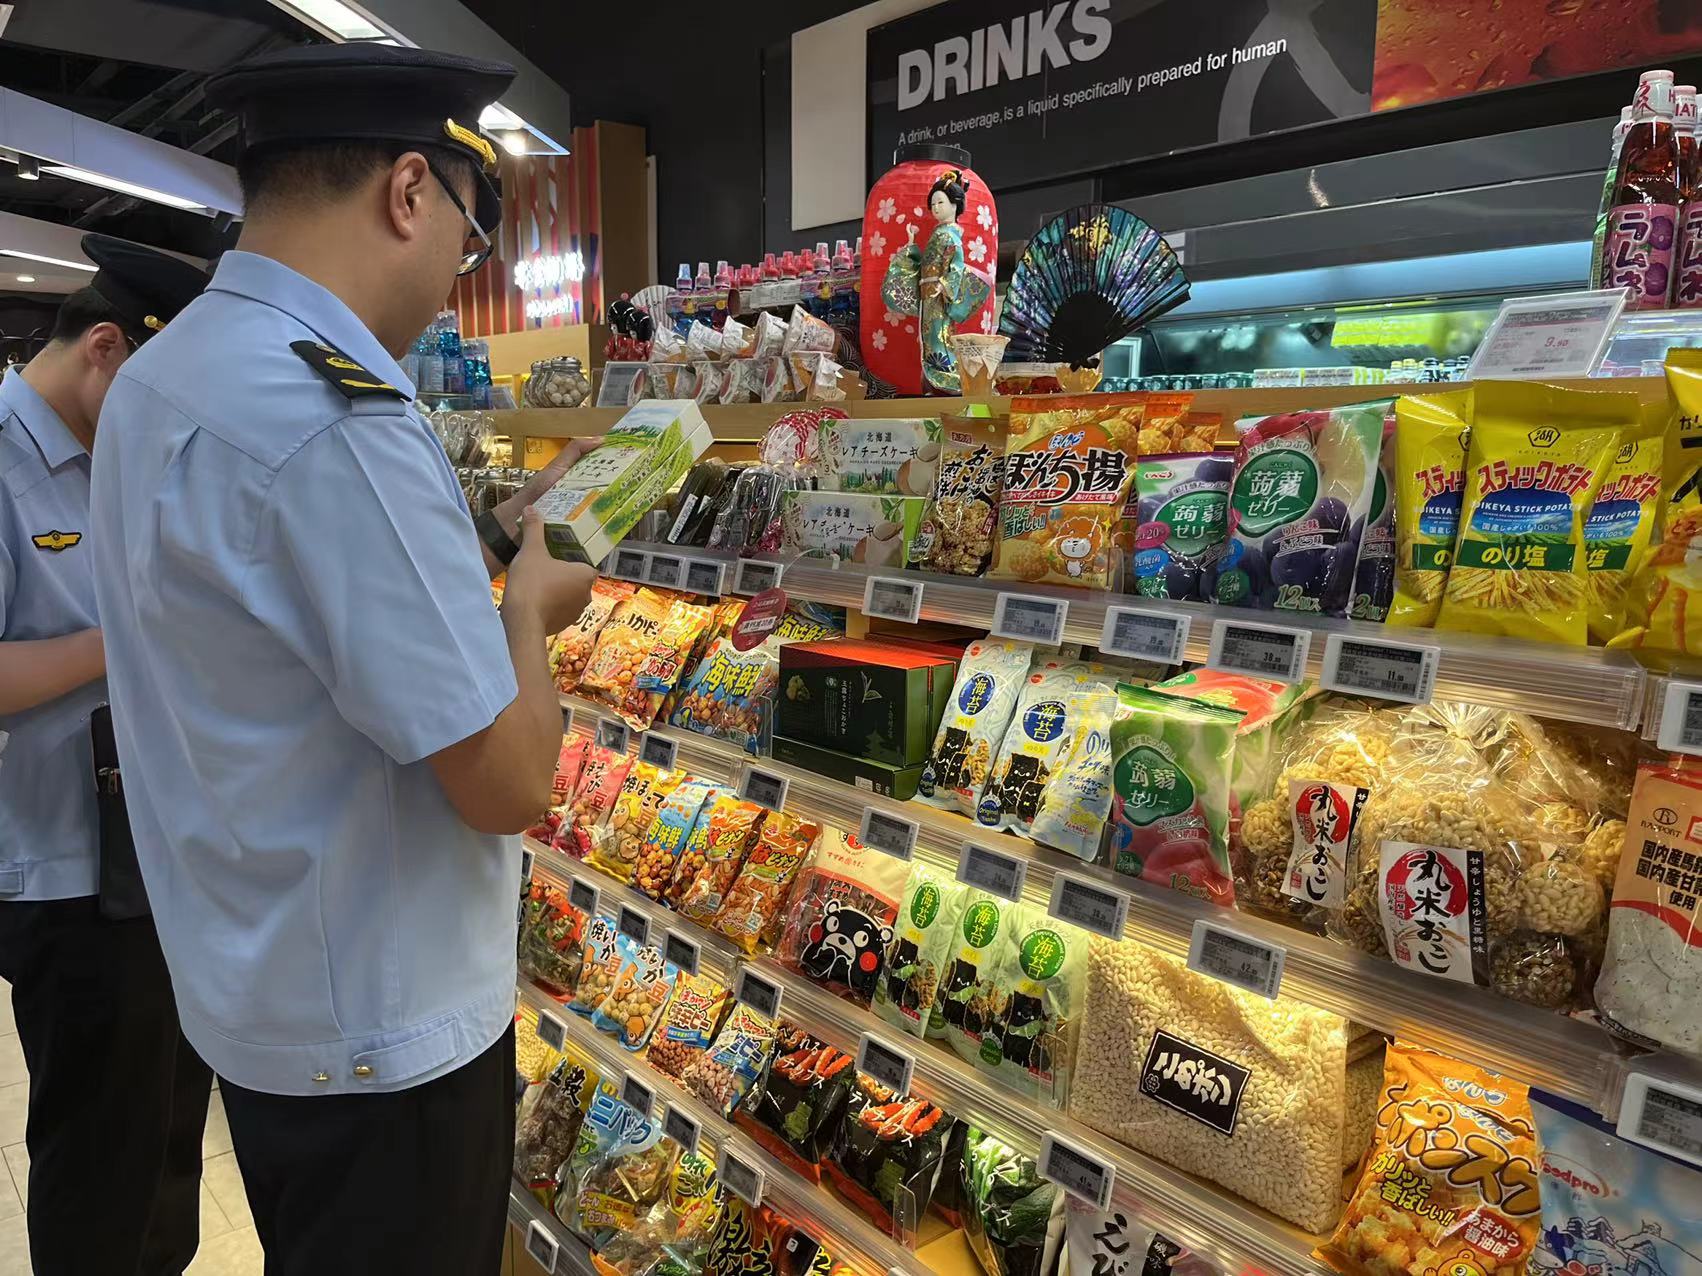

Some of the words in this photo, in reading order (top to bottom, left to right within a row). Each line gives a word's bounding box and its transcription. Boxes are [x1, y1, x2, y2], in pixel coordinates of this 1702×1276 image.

[897, 0, 1112, 111] DRINKS
[899, 133, 906, 145] A
[907, 127, 935, 144] drink,
[937, 125, 948, 136] or
[950, 112, 1003, 135] beverage,
[1004, 107, 1014, 121] is
[1016, 105, 1024, 118] a
[1028, 95, 1058, 117] liquid
[1062, 76, 1132, 107] specifically
[1138, 58, 1201, 91] prepared
[1207, 51, 1228, 72] for
[1232, 37, 1287, 65] human
[1616, 211, 1650, 296] ラムネ
[841, 445, 919, 460] レアチーズケーキ
[866, 431, 893, 442] 北海道
[1478, 459, 1594, 497] スティックポテト
[1514, 505, 1542, 514] STICK
[1480, 545, 1548, 569] のり塩
[966, 677, 989, 714] 海苔
[1034, 704, 1060, 742] 海苔
[552, 774, 569, 792] 豆
[1130, 760, 1177, 791] 蒟蒻
[589, 790, 608, 812] 豆
[1305, 784, 1338, 902] 丸米おこし
[914, 887, 936, 928] 海苔
[1407, 849, 1454, 975] 丸米おこし
[1668, 889, 1697, 912] 使用
[969, 906, 994, 947] 海苔
[1027, 935, 1057, 979] 海苔
[646, 980, 672, 1003] 豆
[1152, 1052, 1233, 1106] こめポン
[1380, 1181, 1456, 1227] 香ばしい!!
[1463, 1225, 1511, 1259] 醤油味
[1465, 1209, 1520, 1247] あまから
